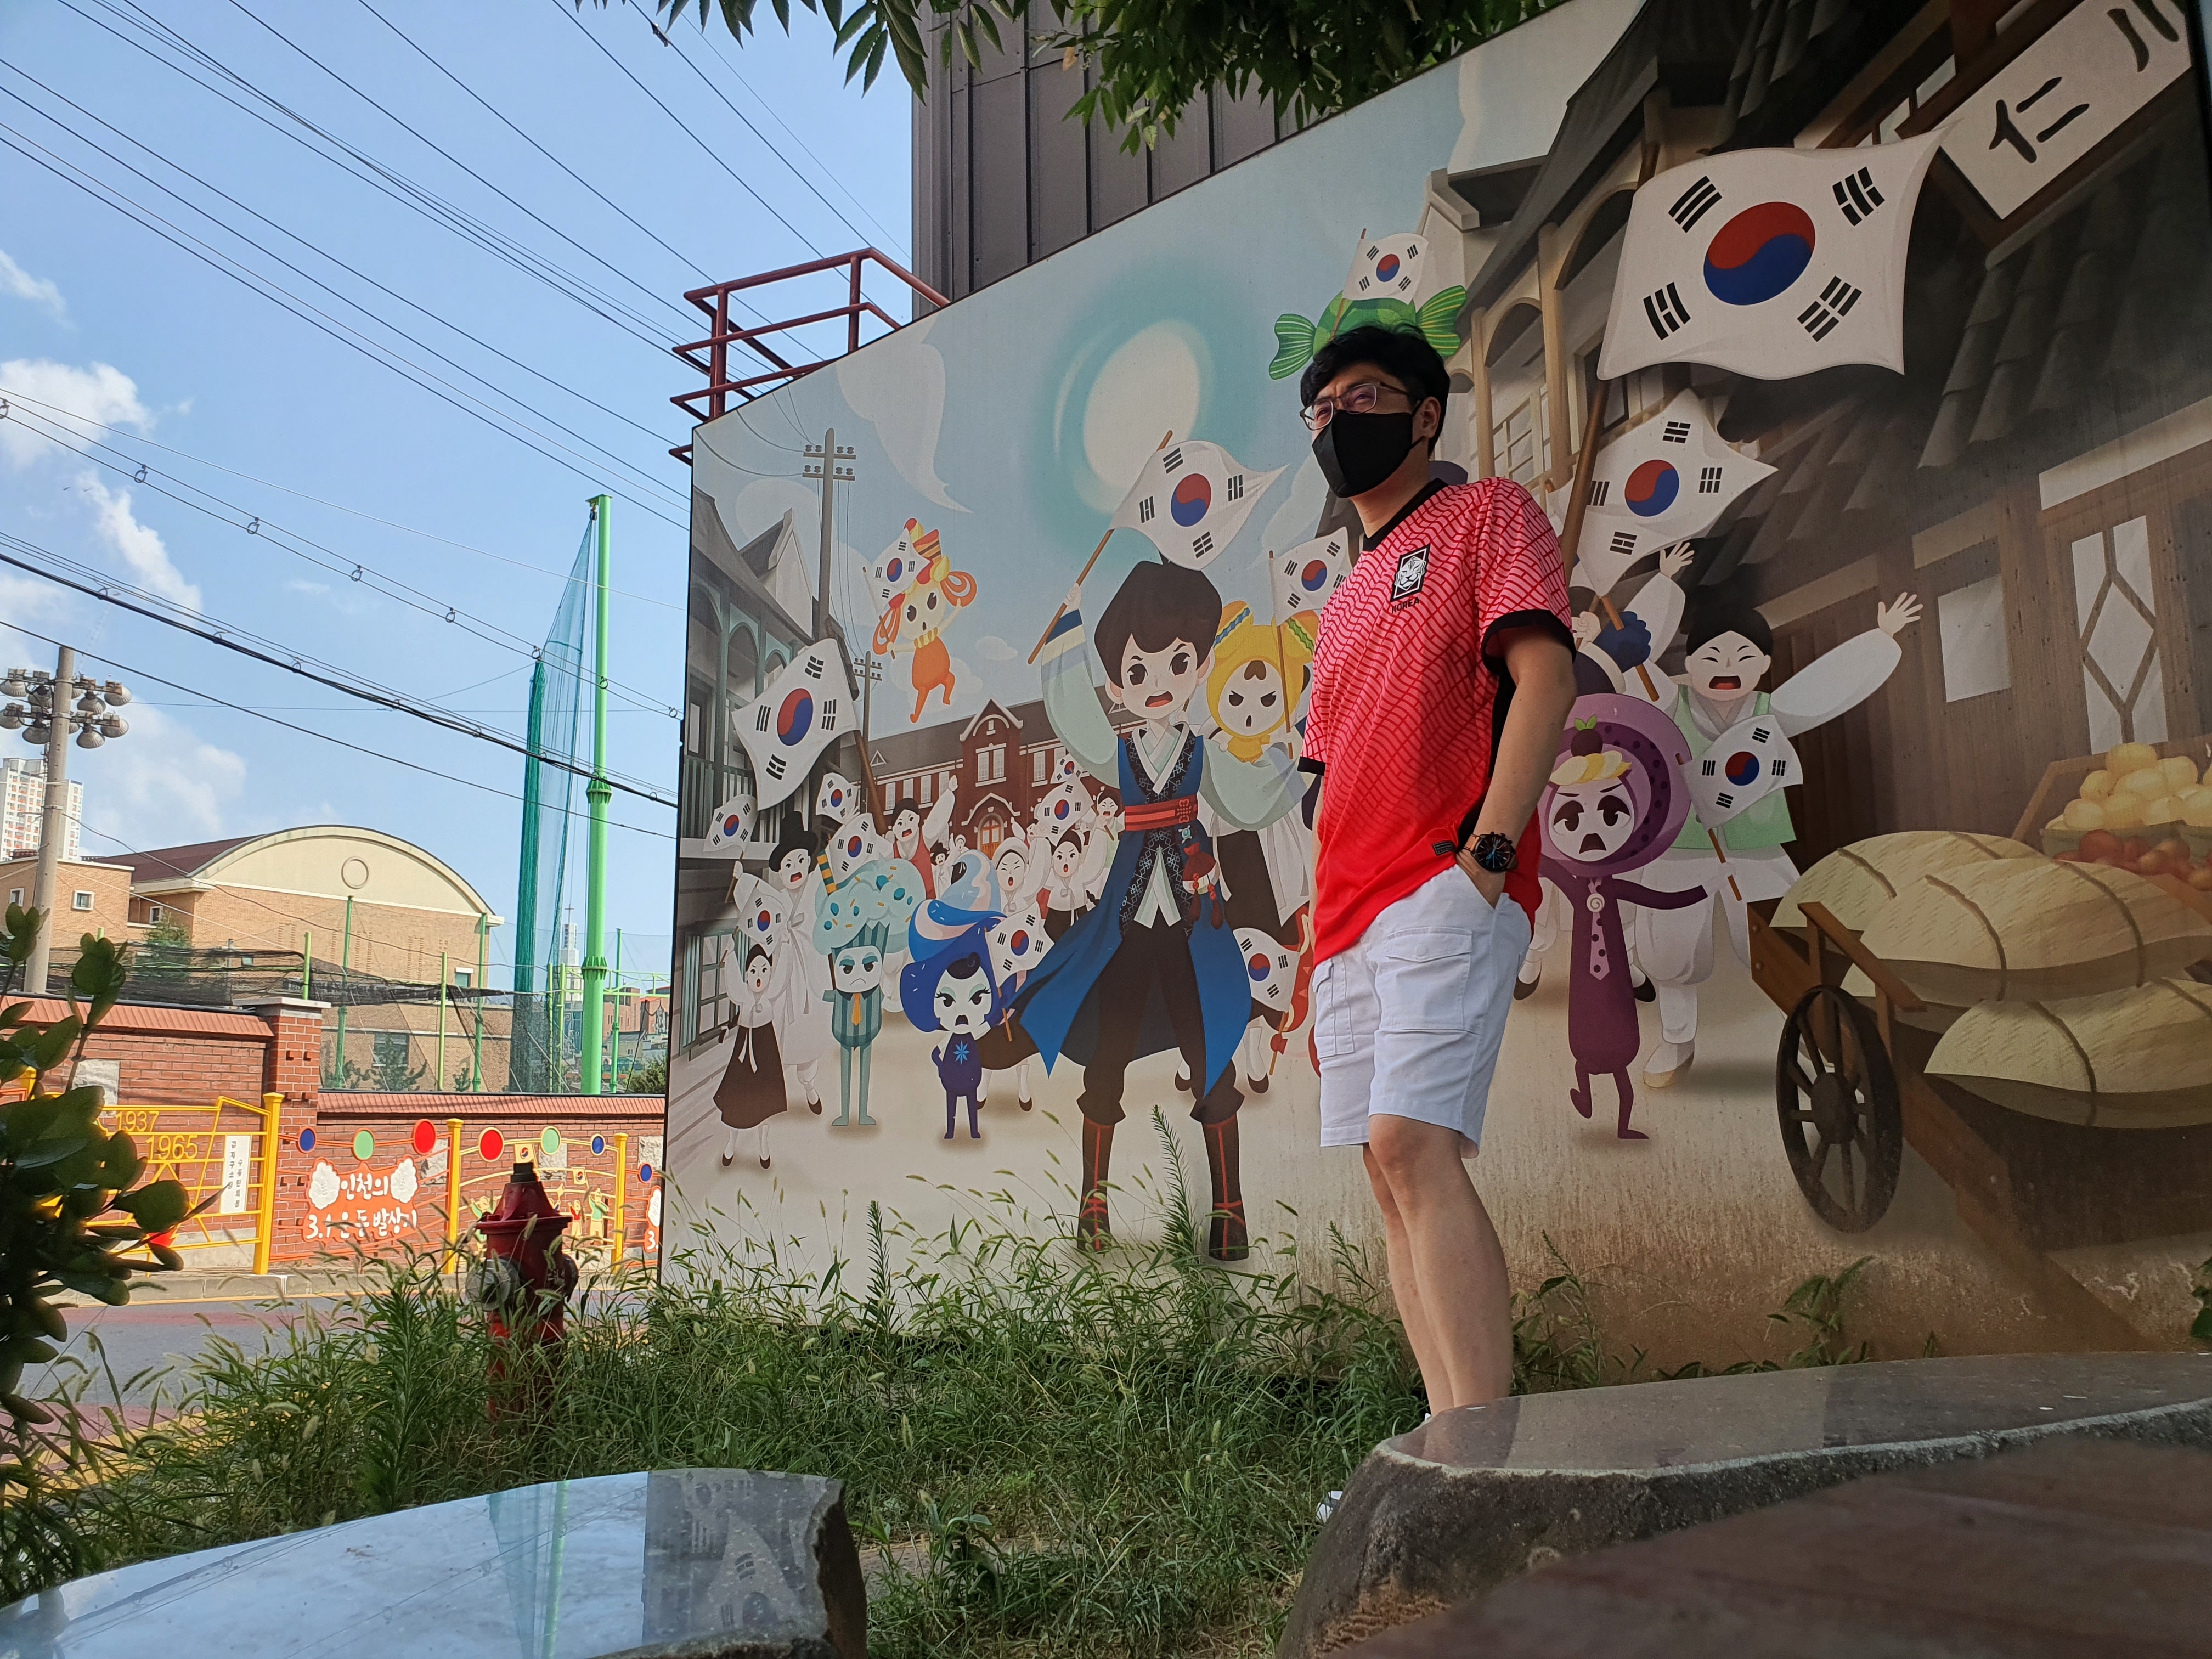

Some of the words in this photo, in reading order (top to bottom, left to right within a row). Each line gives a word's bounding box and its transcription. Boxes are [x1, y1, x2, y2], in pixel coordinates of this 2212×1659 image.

[1391, 596, 1420, 614] KOREA
[115, 1110, 159, 1132] 1937
[145, 1135, 198, 1160] 1965
[341, 1173, 388, 1200] 인천의
